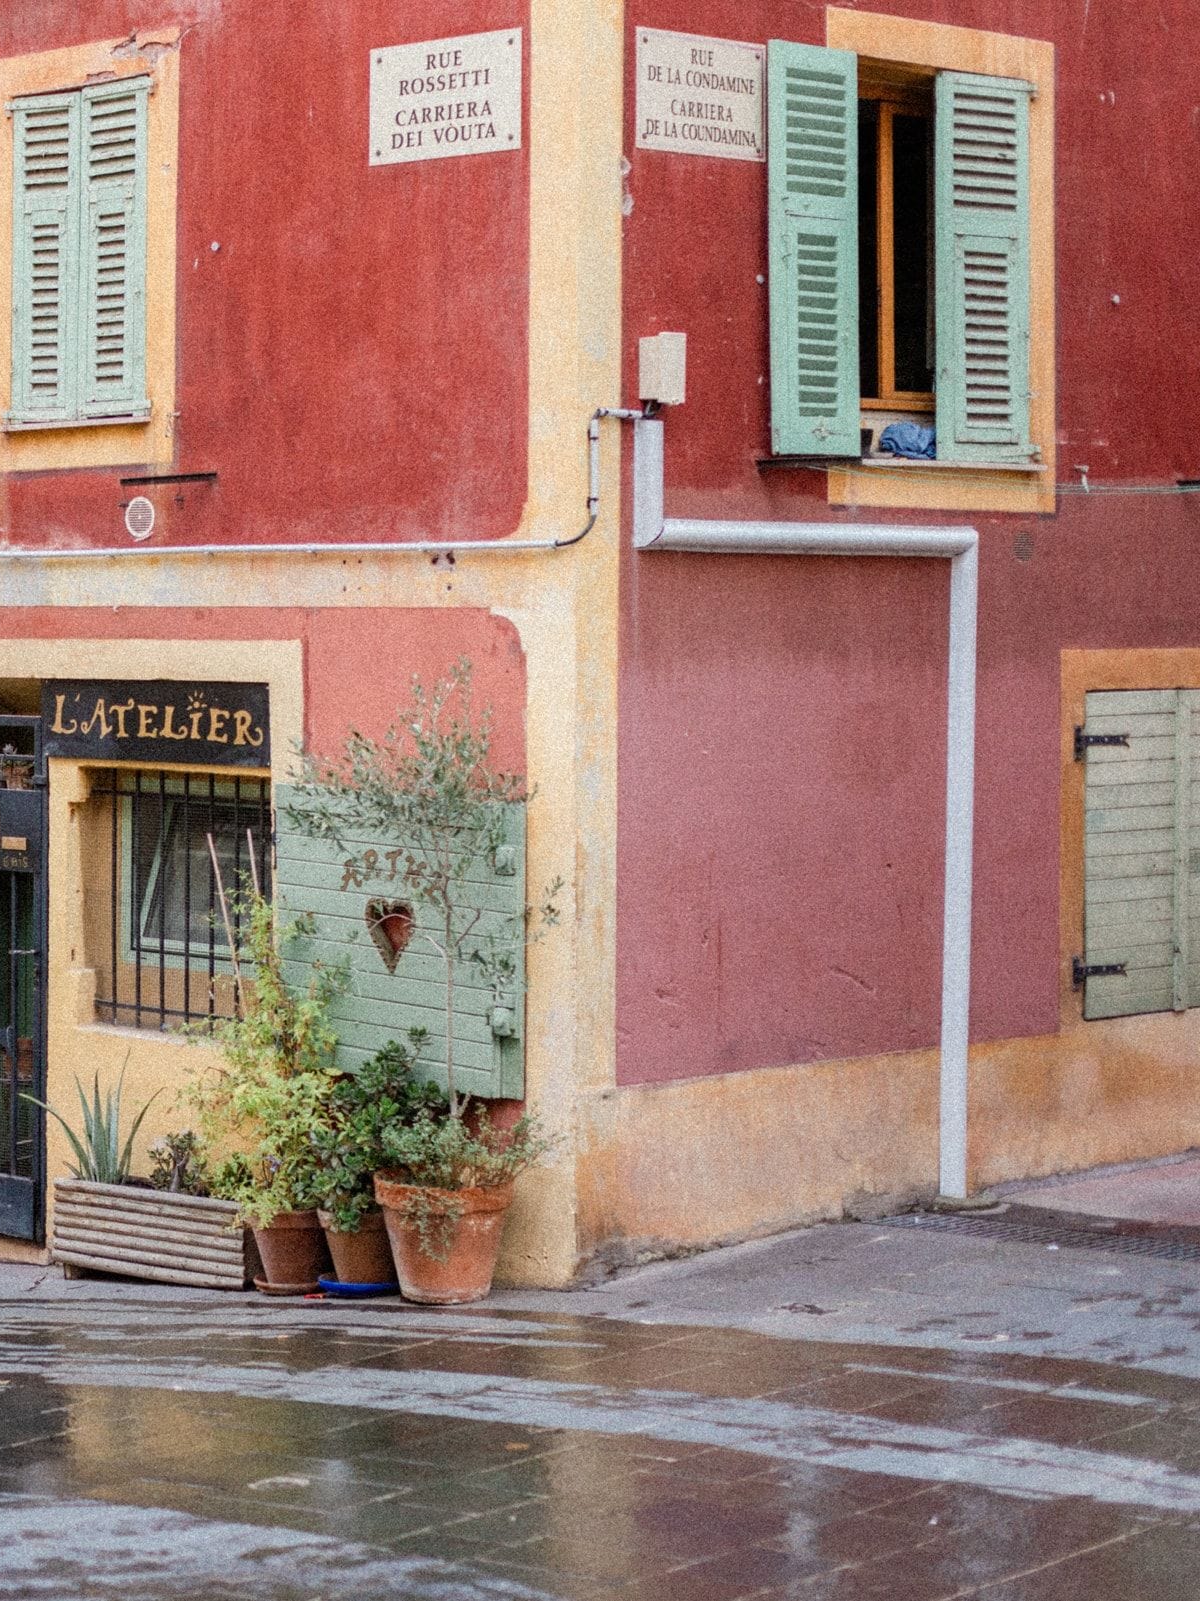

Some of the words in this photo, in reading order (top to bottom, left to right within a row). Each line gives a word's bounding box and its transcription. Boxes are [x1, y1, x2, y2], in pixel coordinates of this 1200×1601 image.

[425, 50, 463, 71] RUE
[691, 48, 714, 67] RUE
[399, 68, 491, 96] ROSSETTI
[647, 65, 662, 82] DE
[667, 67, 681, 85] LA
[685, 69, 755, 95] CONDAMINE
[395, 100, 493, 127] CARRIERA
[670, 99, 734, 123] CARRIERA
[391, 130, 423, 150] DEI
[646, 118, 660, 136] DE
[664, 121, 678, 139] LA
[681, 123, 757, 147] COUNDAMINA
